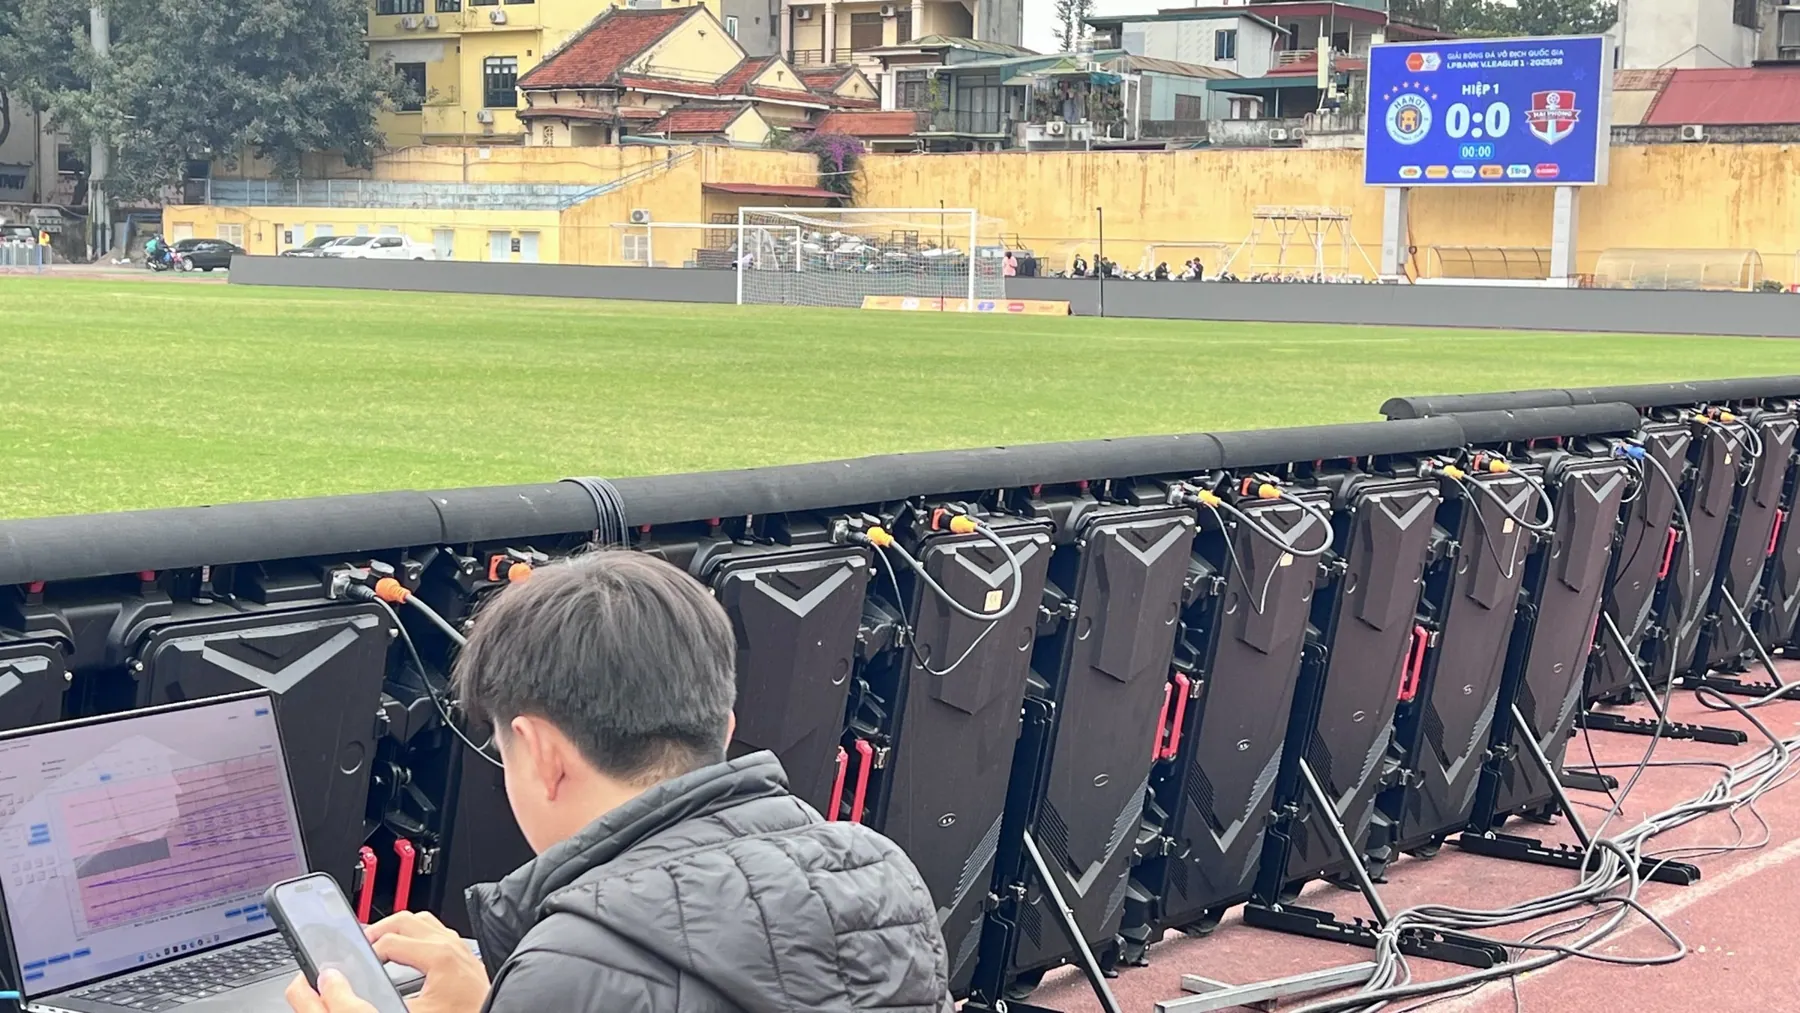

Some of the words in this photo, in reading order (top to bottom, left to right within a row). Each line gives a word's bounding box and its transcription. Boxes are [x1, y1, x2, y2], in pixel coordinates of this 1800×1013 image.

[1480, 60, 1519, 68] V.LEAGUE
[1530, 58, 1564, 67] 2025/26
[1462, 81, 1491, 98] HIỆP
[1493, 83, 1499, 95] 1
[1445, 101, 1511, 139] 0:0
[1462, 145, 1491, 158] 00:00
